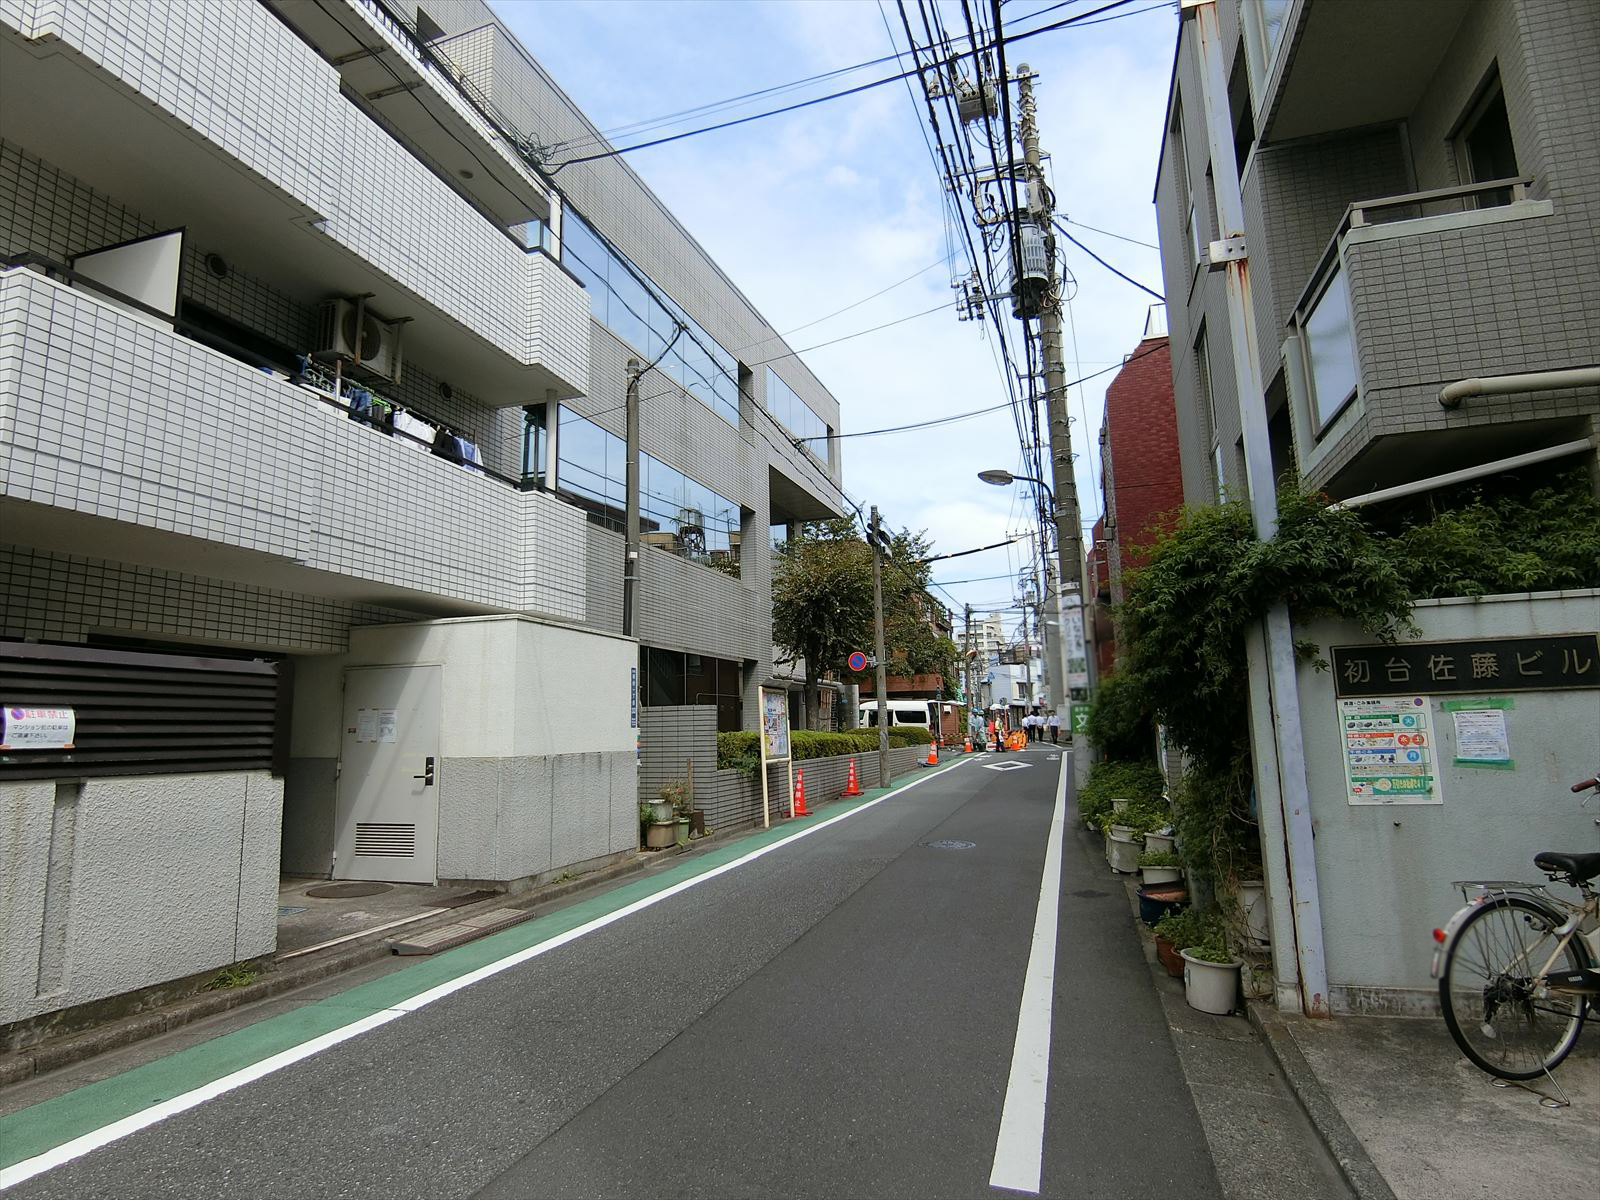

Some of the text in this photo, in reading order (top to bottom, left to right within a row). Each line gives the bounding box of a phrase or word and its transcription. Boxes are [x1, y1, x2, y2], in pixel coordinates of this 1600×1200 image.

[1343, 648, 1592, 684] 初台佐藤ビル
[26, 710, 69, 719] 駐車禁止
[1075, 713, 1089, 728] 文
